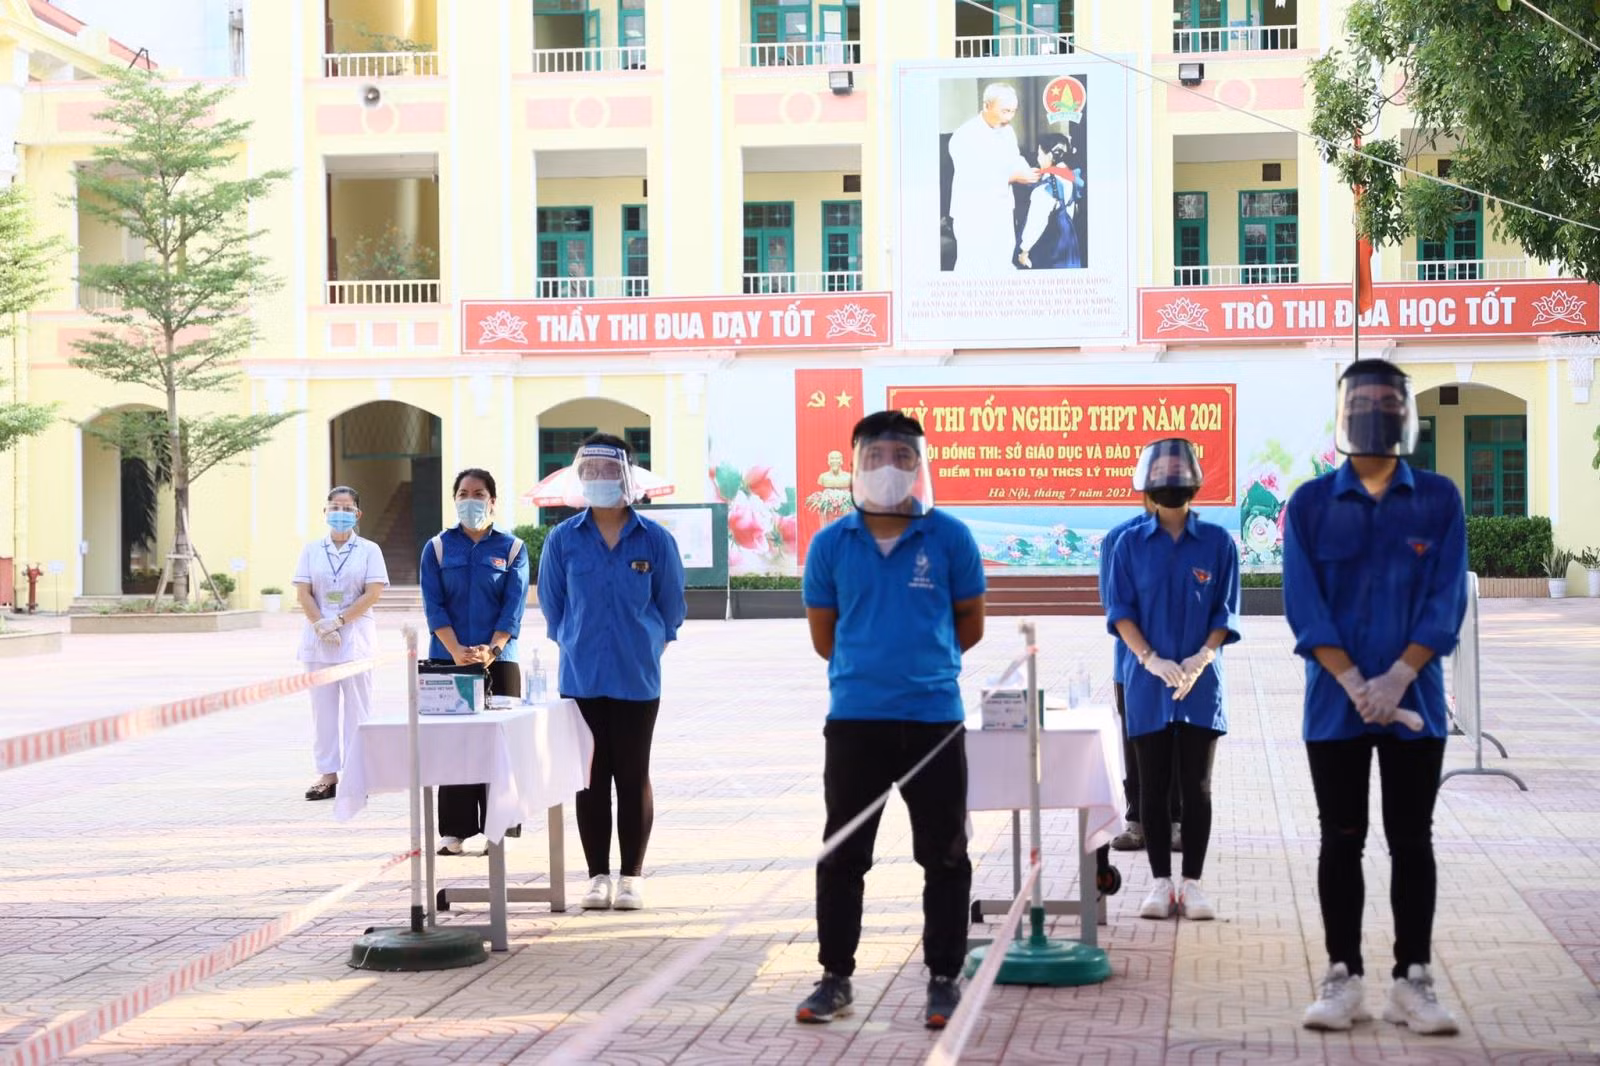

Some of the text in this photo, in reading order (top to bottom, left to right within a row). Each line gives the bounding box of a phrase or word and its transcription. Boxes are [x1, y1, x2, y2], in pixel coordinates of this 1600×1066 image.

[536, 300, 816, 345] THẦY THI ĐUA DẠY TỐT
[1220, 294, 1274, 330] TRÒ
[1282, 300, 1326, 328] THI
[1399, 297, 1457, 333] HỌC
[1464, 286, 1517, 326] TỐT
[932, 406, 965, 432] THI
[969, 394, 1008, 432] TỐT
[1011, 398, 1083, 439] NGHIỆP
[1087, 405, 1138, 432] THPT
[1142, 398, 1186, 431] NĂM
[1190, 403, 1222, 431] 2021
[979, 445, 1002, 459] THI:
[1005, 440, 1023, 459] SỞ
[1025, 441, 1055, 459] GIÁO
[1057, 445, 1083, 462] DỤC
[1086, 443, 1103, 459] VÀ
[1105, 442, 1131, 459] ĐÀO
[974, 467, 993, 478] THI
[996, 467, 1026, 478] 0410
[1029, 467, 1049, 479] TẠI
[1051, 467, 1083, 477] THCS
[1086, 464, 1101, 477] LÝ
[1104, 464, 1137, 477] THƯỜ
[988, 487, 1133, 499] Hà Nội, tháng 7 năm 2021
